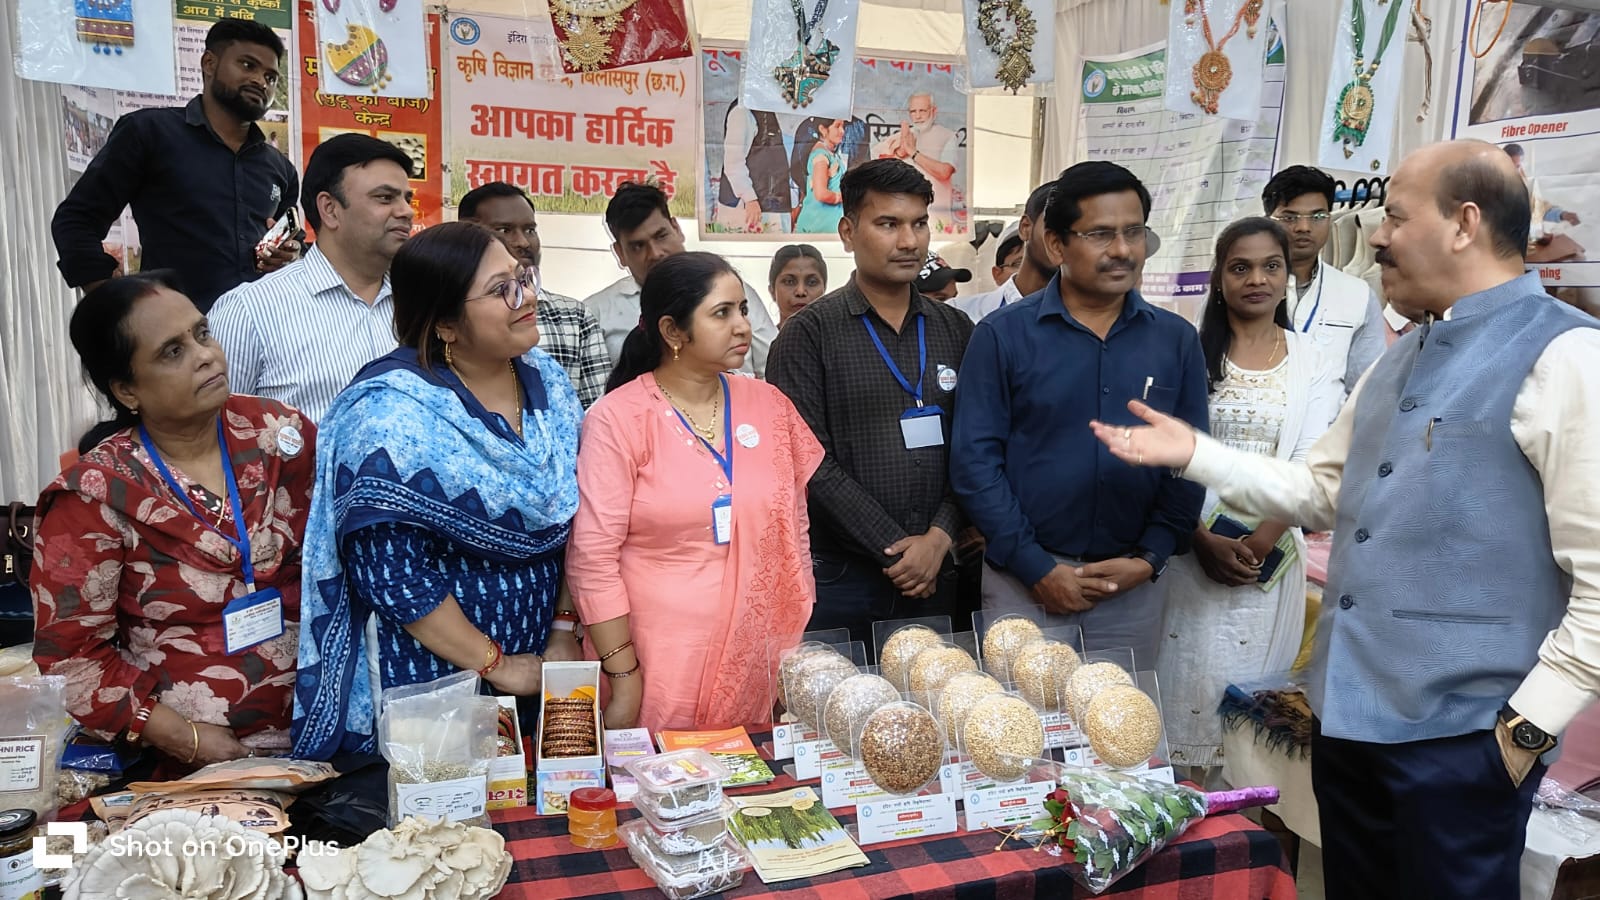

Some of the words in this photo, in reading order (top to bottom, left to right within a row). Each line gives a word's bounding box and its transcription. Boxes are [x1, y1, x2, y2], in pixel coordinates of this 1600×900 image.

[184, 6, 209, 16] आय
[215, 6, 225, 17] में
[507, 30, 527, 44] इंदिरा
[456, 49, 488, 83] कृषि
[492, 51, 534, 81] विज्ञान
[645, 67, 686, 97] (छ.ग.)
[354, 107, 392, 127] केन्द्र
[470, 104, 576, 142] आपका
[584, 107, 675, 148] हार्दिक
[1501, 124, 1526, 138] Fibre
[1527, 121, 1569, 136] Opener
[466, 159, 565, 194] स्वागत
[16, 745, 35, 753] RICE
